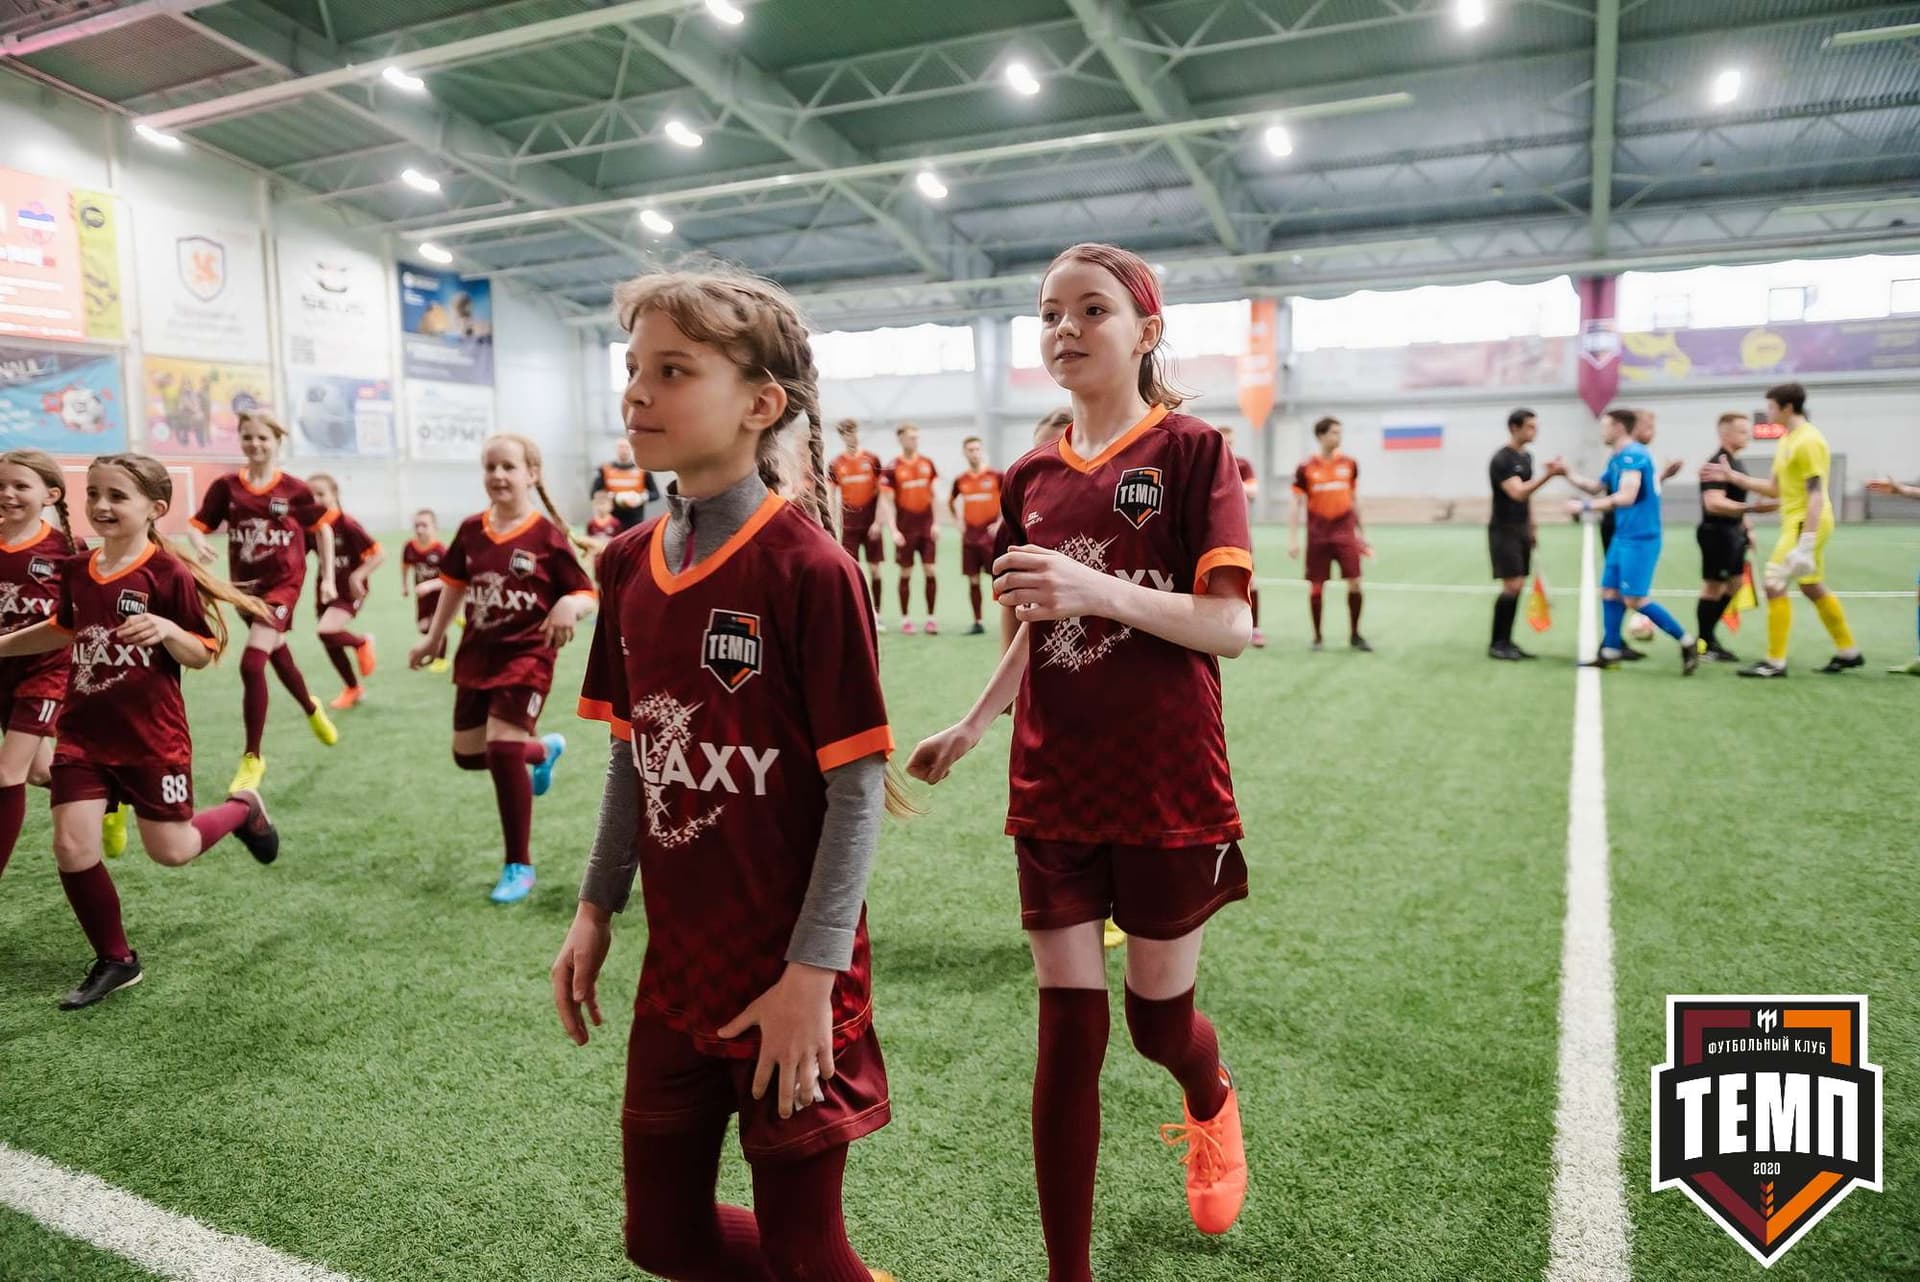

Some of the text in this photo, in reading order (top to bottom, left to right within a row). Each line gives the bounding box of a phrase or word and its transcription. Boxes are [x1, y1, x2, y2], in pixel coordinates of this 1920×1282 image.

[1120, 483, 1158, 507] ТЕМП
[708, 634, 757, 665] ТЕМП
[38, 699, 57, 723] 11
[162, 774, 188, 804] 88
[1213, 842, 1231, 886] 7
